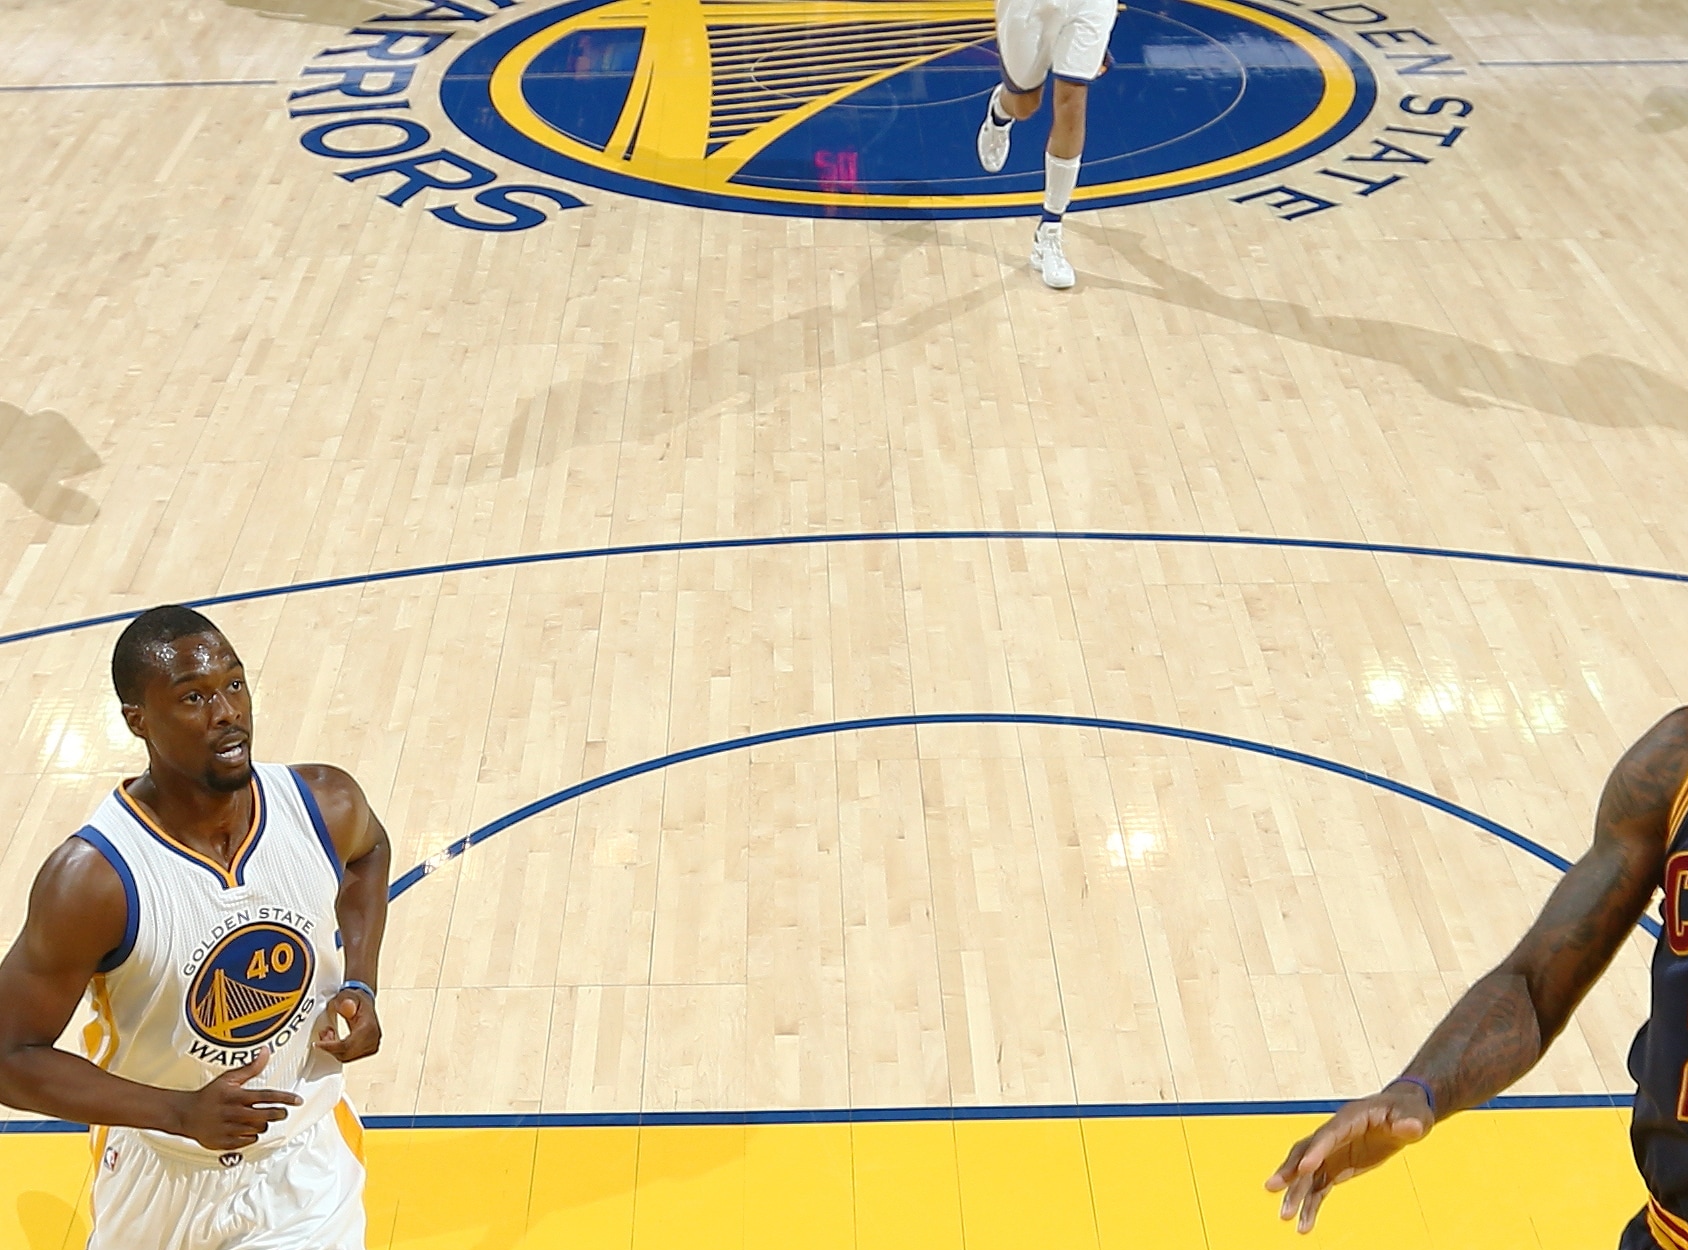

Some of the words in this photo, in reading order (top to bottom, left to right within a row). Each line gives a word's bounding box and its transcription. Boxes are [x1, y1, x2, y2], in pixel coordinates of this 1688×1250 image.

[287, 0, 590, 232] ARRIORS
[1229, 94, 1474, 221] STATE
[183, 909, 251, 977] GOLDEN
[258, 907, 314, 935] STATE
[247, 942, 295, 980] 40
